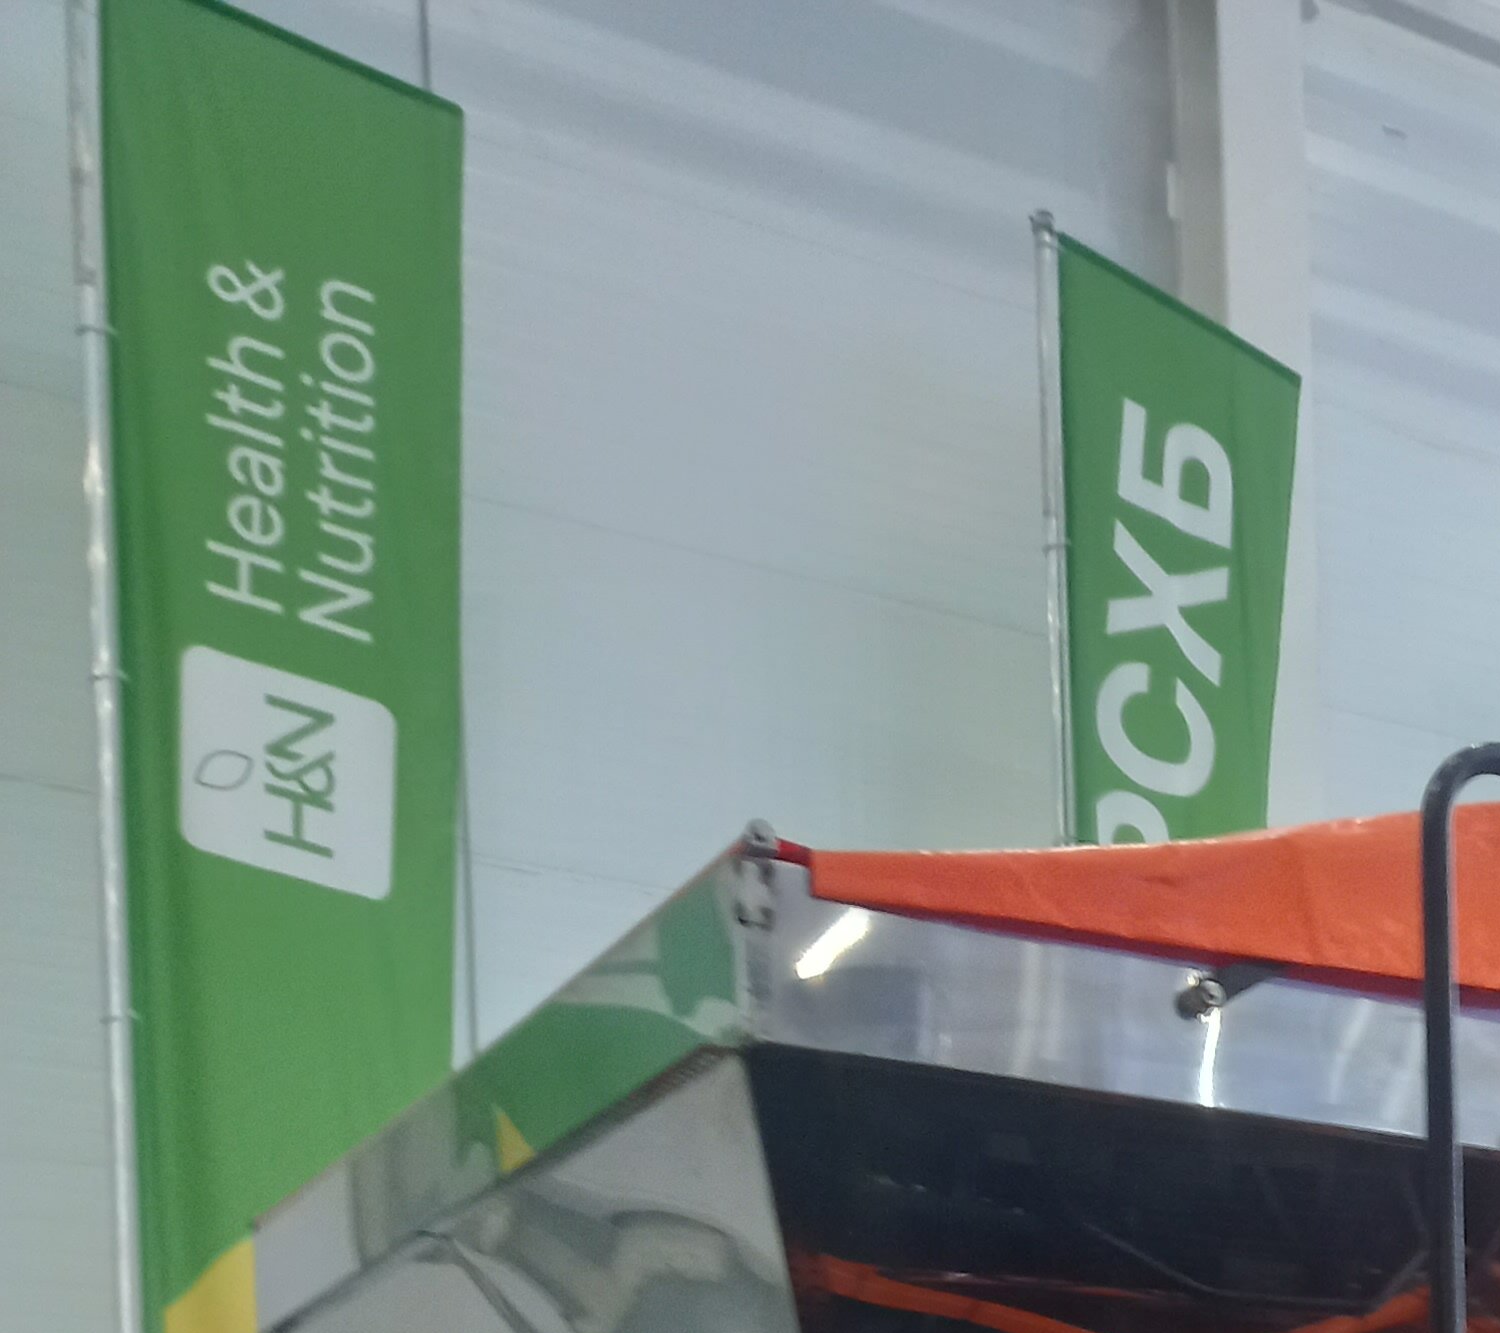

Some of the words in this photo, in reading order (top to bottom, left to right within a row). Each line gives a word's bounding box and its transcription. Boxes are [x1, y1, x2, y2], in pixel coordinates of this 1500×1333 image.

[207, 259, 286, 322] &
[206, 335, 284, 615] Health
[299, 278, 377, 644] Nutrition
[263, 693, 336, 859] H&N
